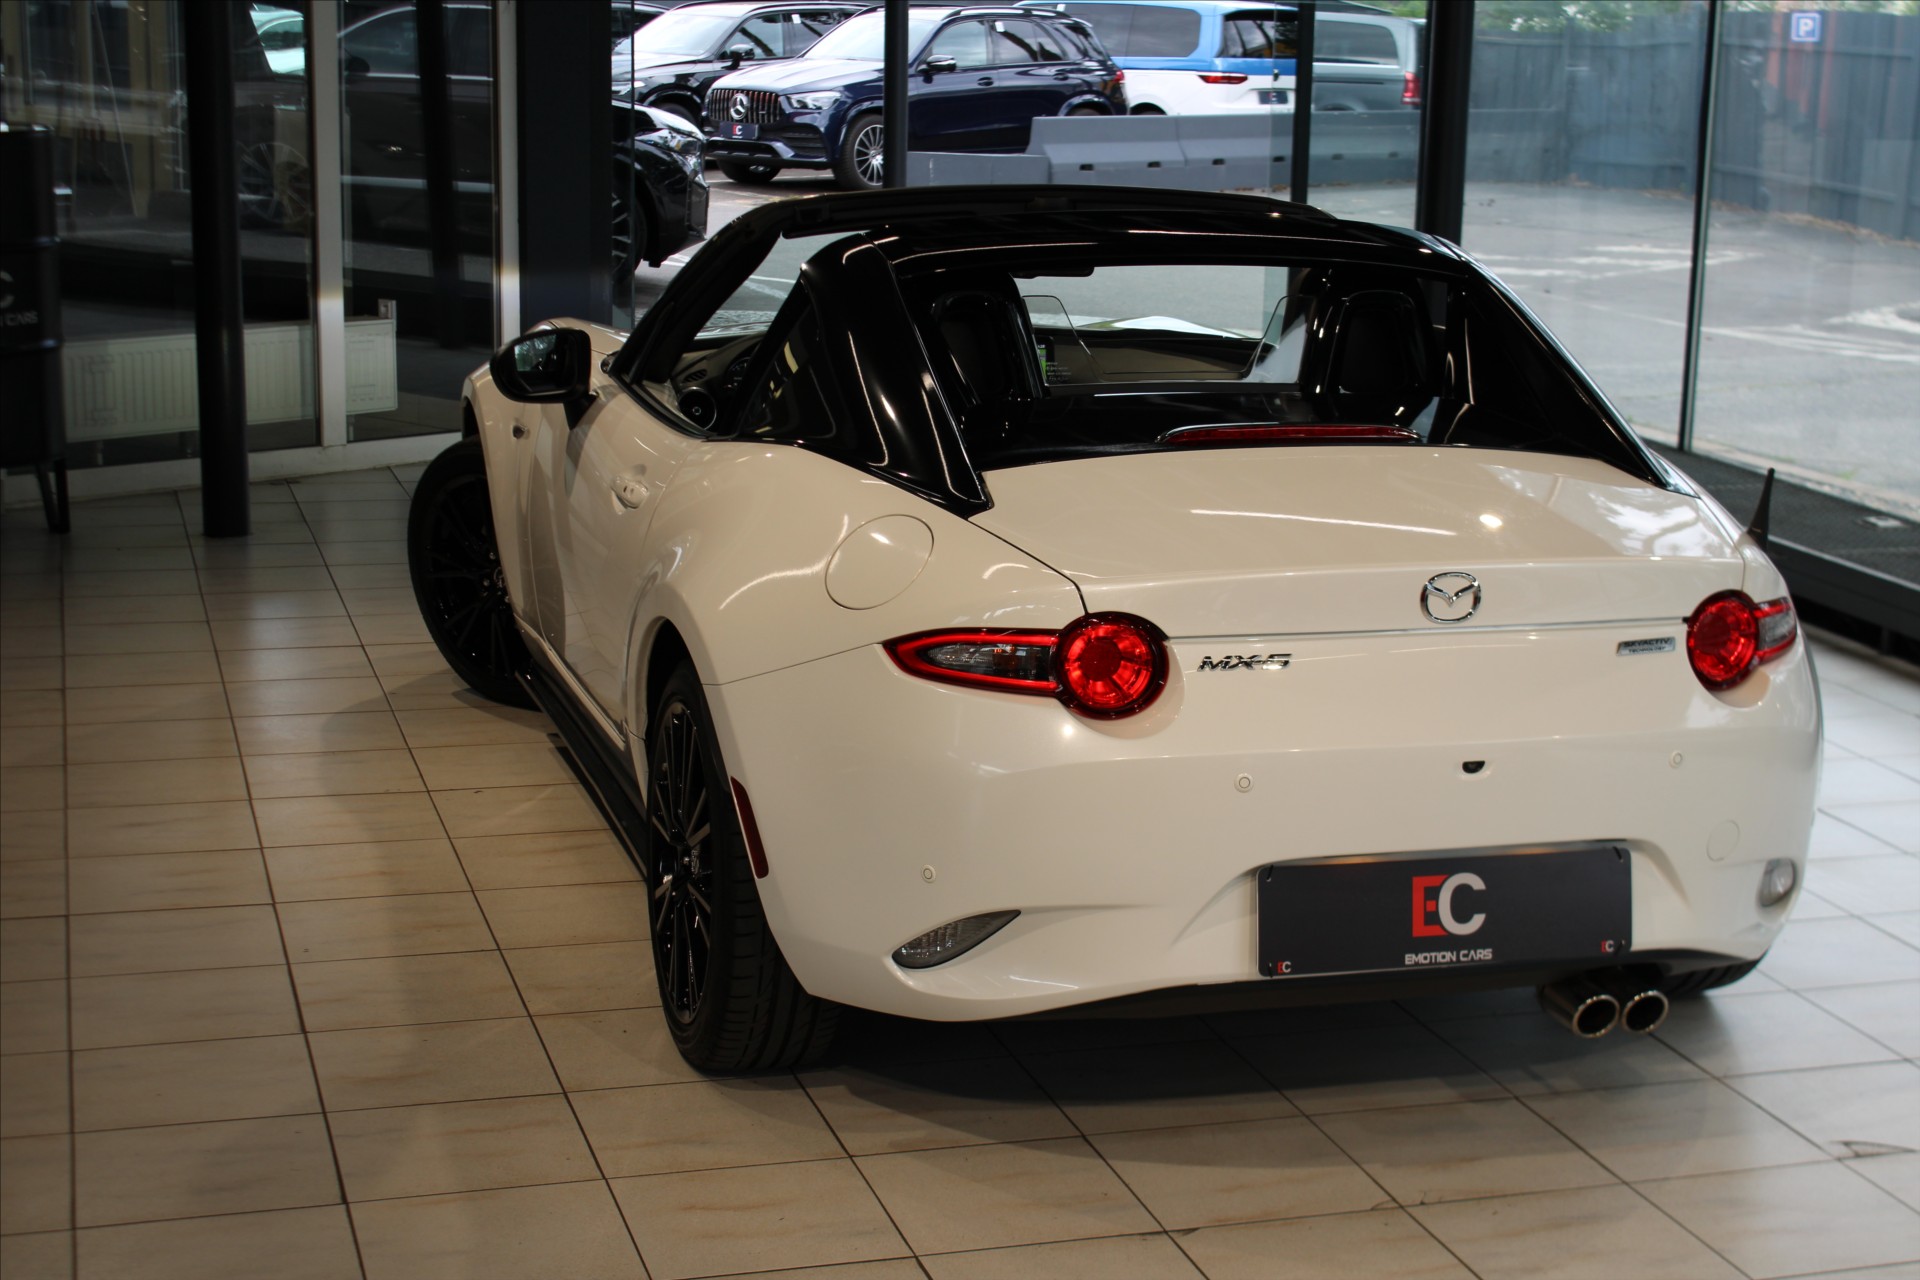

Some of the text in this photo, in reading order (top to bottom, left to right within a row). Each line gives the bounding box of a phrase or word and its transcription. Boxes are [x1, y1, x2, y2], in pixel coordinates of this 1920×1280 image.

[1799, 18, 1814, 36] P
[1197, 653, 1293, 672] MX-5
[1412, 872, 1487, 938] EC
[1405, 948, 1493, 965] EMOTION CARS
